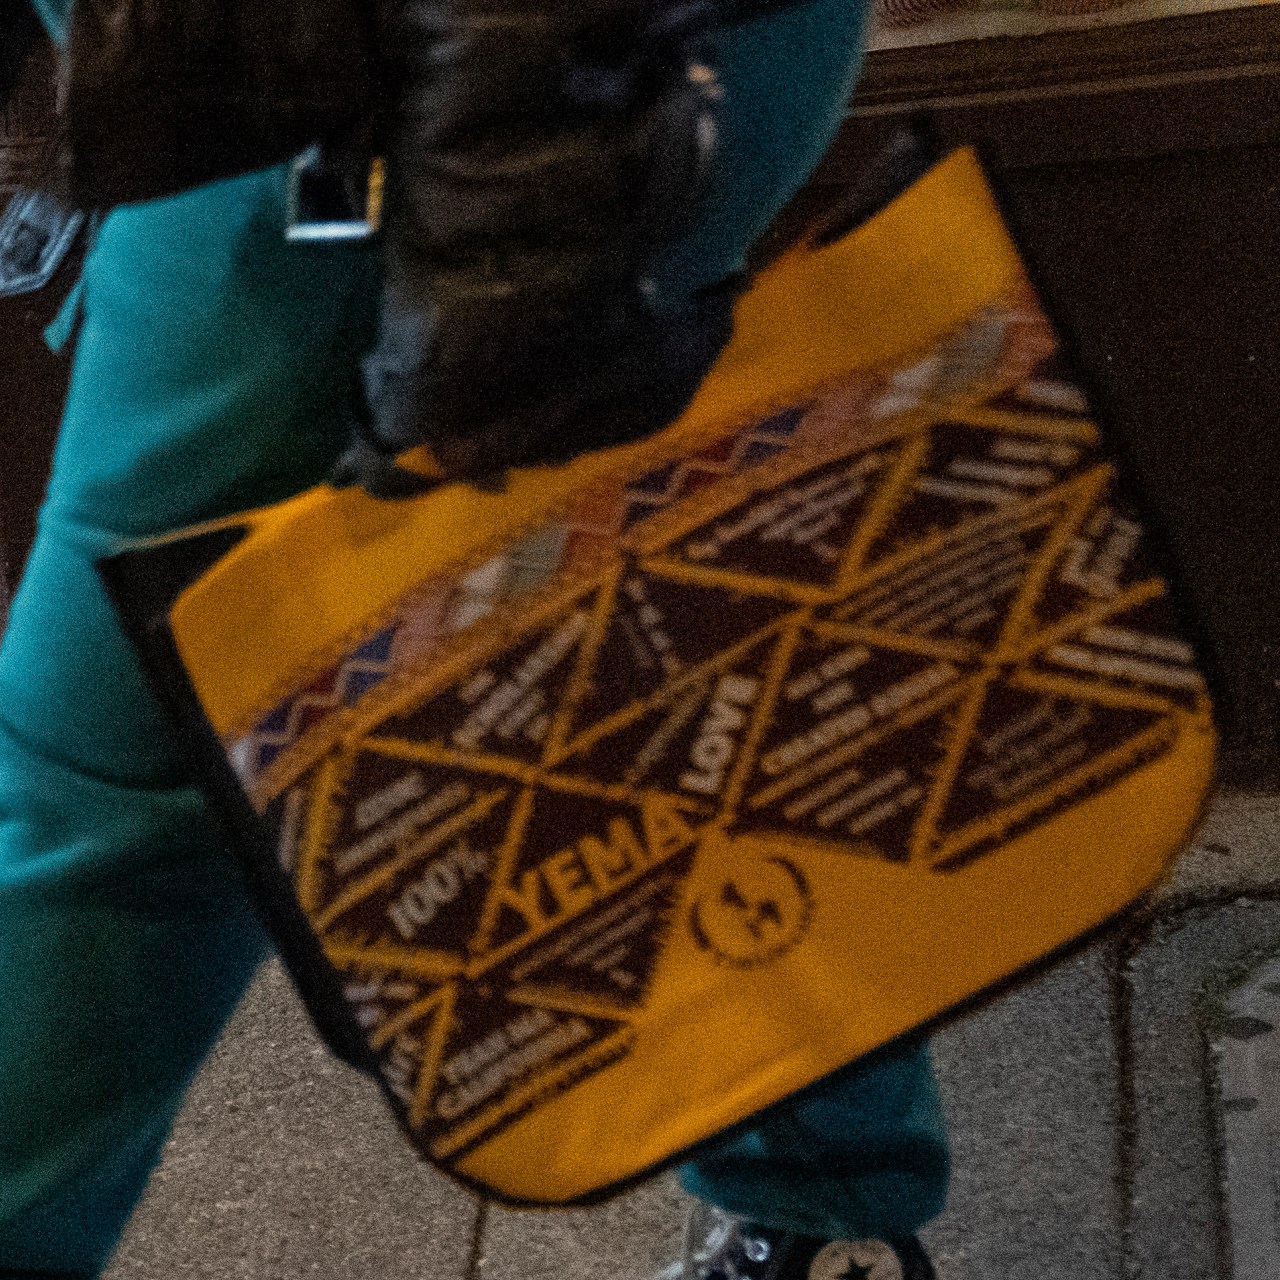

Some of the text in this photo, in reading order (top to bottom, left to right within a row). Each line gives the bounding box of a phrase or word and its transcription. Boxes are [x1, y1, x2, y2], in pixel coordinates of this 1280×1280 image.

[677, 674, 761, 794] LOVE
[382, 837, 491, 938] 100%
[498, 793, 697, 929] YEMA
